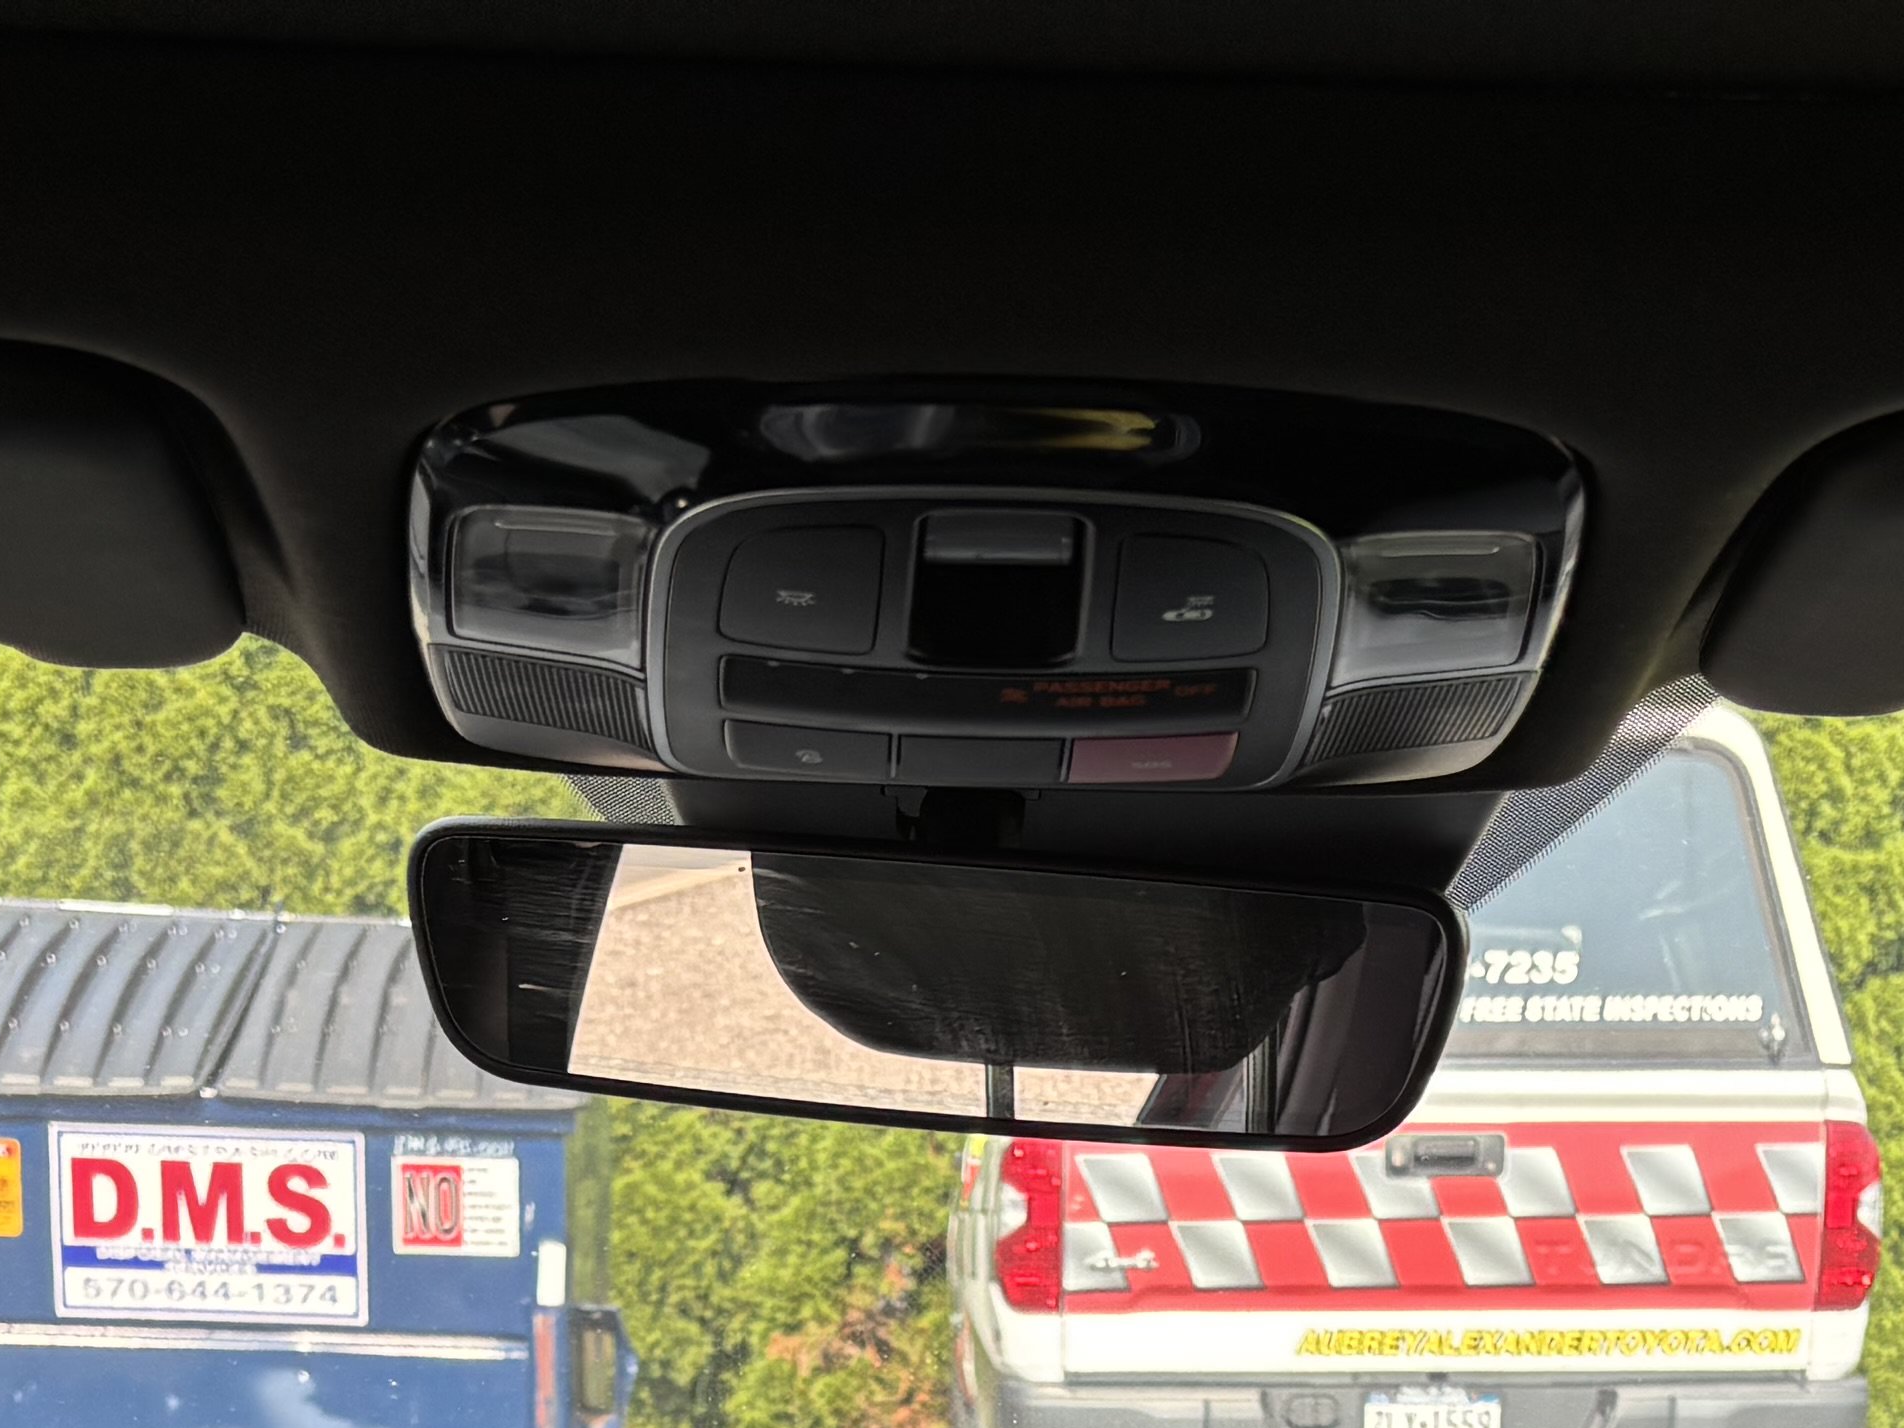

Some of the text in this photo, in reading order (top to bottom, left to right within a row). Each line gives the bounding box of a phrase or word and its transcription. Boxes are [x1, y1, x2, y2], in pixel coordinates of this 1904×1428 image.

[1033, 679, 1172, 694] PASSENGER
[1174, 683, 1218, 697] OFF
[1525, 996, 1601, 1023] STATE
[1603, 994, 1763, 1023] INSPECTIONS
[70, 1156, 347, 1250] D.M.S.
[402, 1172, 460, 1240] NO
[82, 1276, 339, 1305] 570-644-1374
